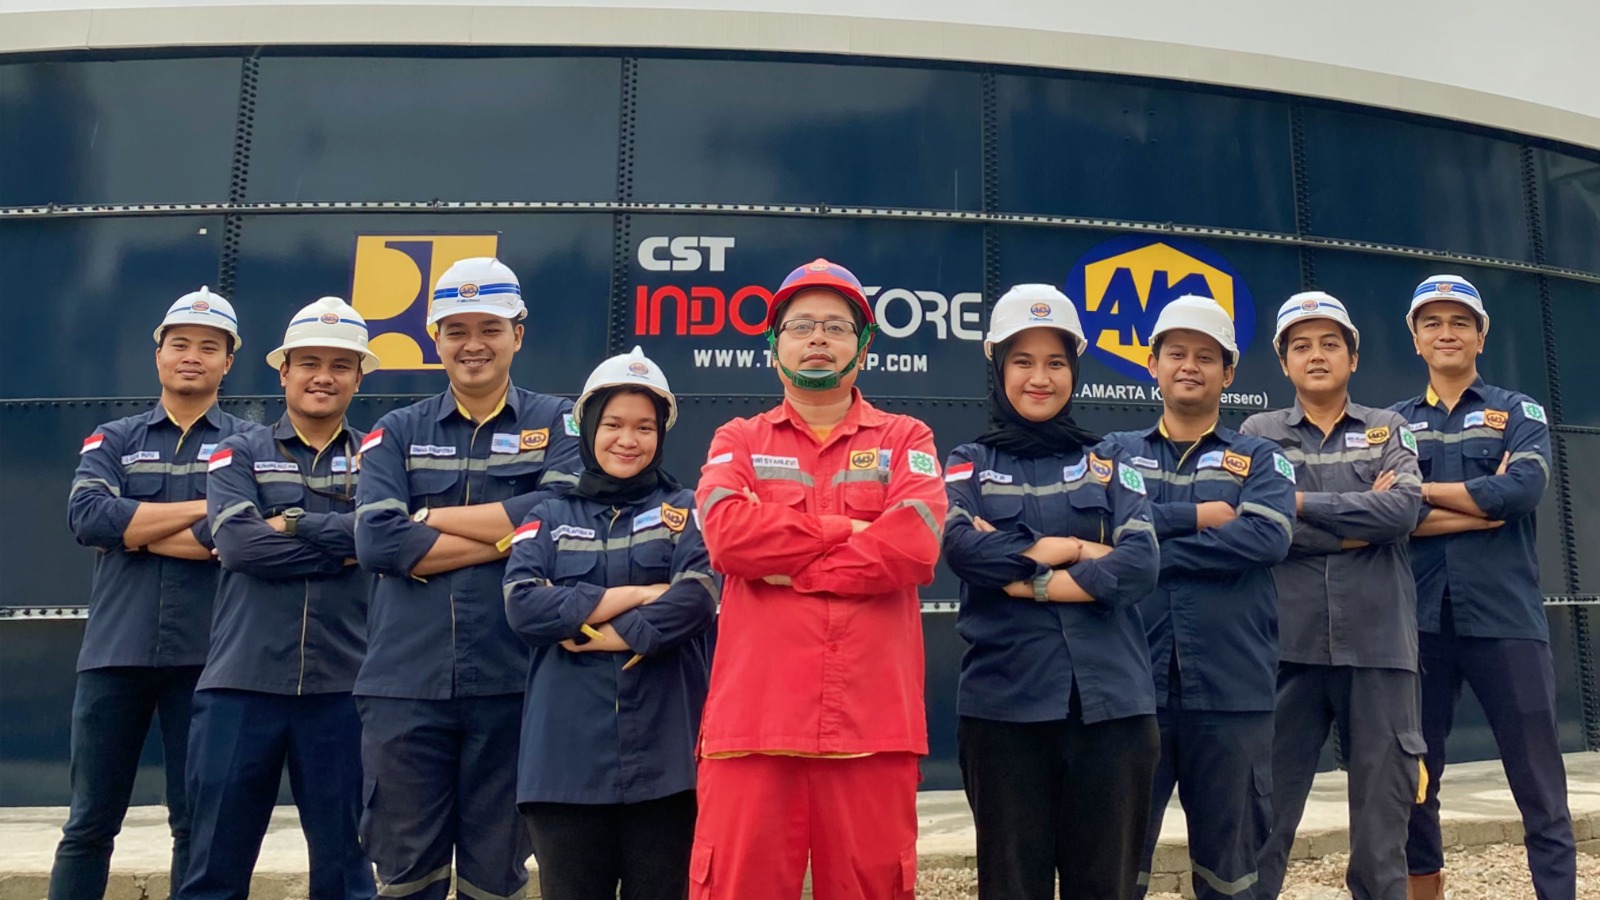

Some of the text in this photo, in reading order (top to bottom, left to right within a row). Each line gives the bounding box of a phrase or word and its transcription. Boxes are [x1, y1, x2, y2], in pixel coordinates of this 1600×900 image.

[637, 236, 736, 272] CST
[1072, 383, 1147, 400] .AMARTA
[1220, 391, 1269, 409] ersero)
